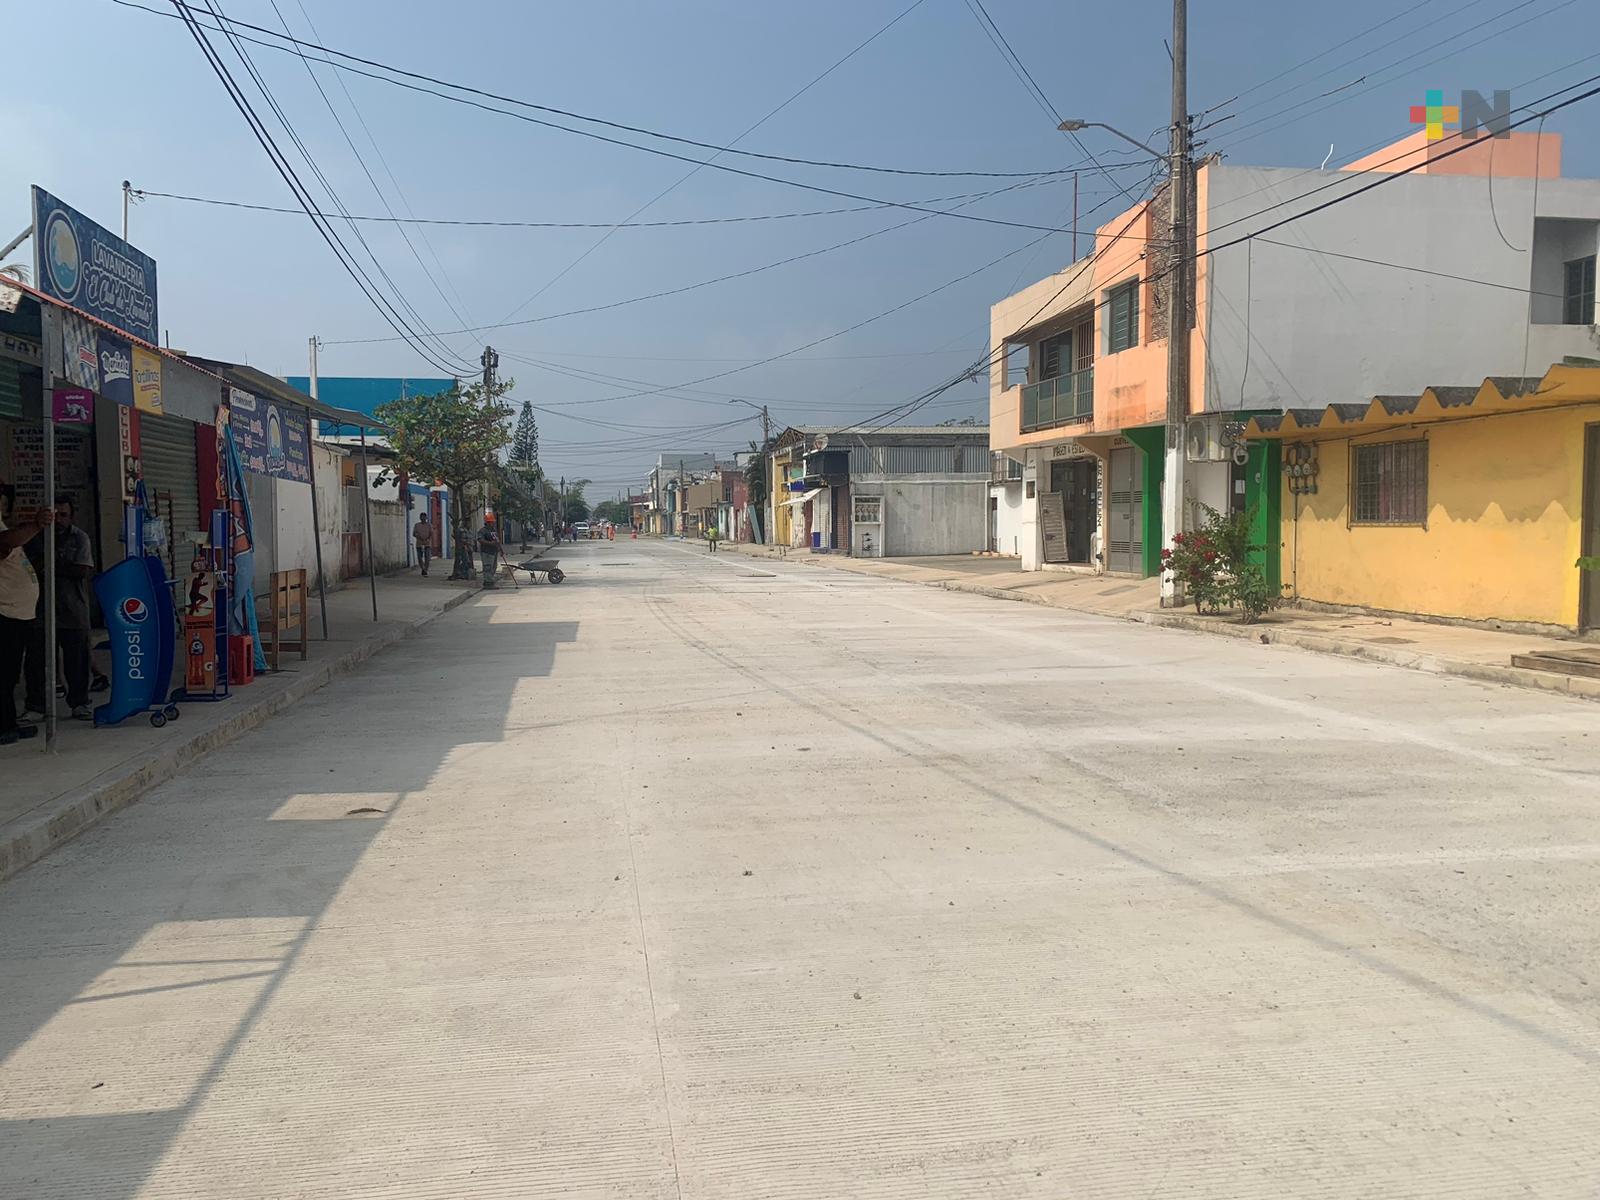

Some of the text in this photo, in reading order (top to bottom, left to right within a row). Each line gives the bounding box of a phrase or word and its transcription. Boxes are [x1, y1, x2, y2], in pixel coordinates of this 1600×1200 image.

[94, 244, 144, 290] LAVANDERIA
[120, 407, 129, 452] CLUB
[125, 630, 145, 680] pepsi
